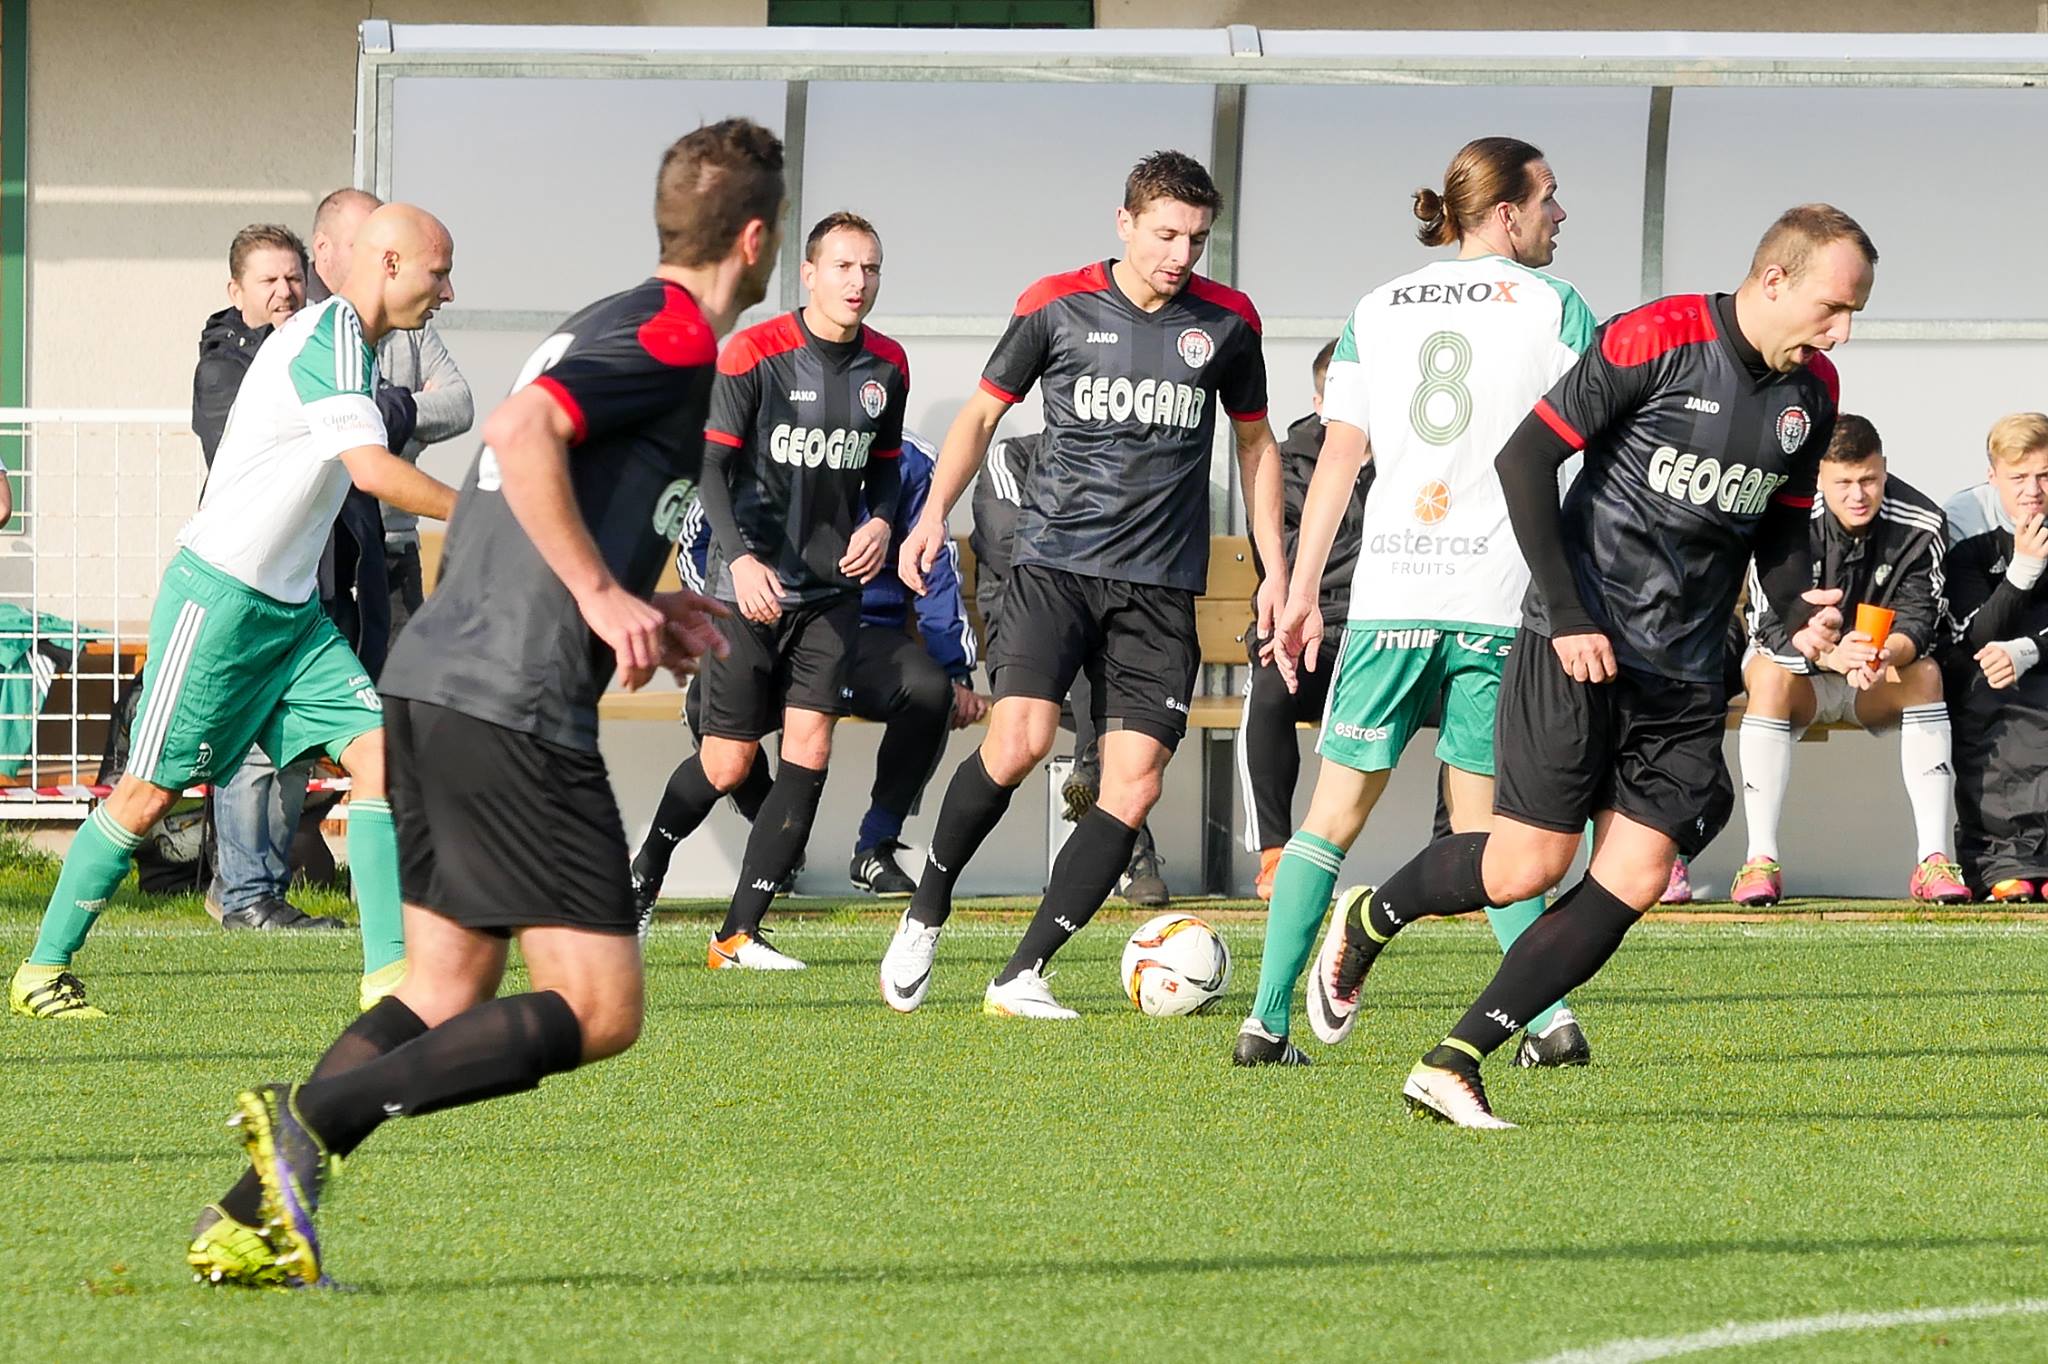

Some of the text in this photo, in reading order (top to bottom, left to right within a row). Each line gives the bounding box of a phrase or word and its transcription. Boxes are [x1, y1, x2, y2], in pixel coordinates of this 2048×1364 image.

[1389, 280, 1520, 307] KENOX
[1086, 331, 1119, 344] JAKO
[789, 389, 818, 402] JAKO
[1073, 375, 1206, 429] GEOGARD
[1409, 330, 1473, 447] 8
[1684, 396, 1720, 415] JAKO
[769, 423, 877, 470] GEOGAR
[1647, 446, 1789, 515] GEOGAR
[1370, 527, 1489, 556] asteras
[1391, 561, 1456, 576] FRUITS
[1484, 1008, 1520, 1032] JAK
